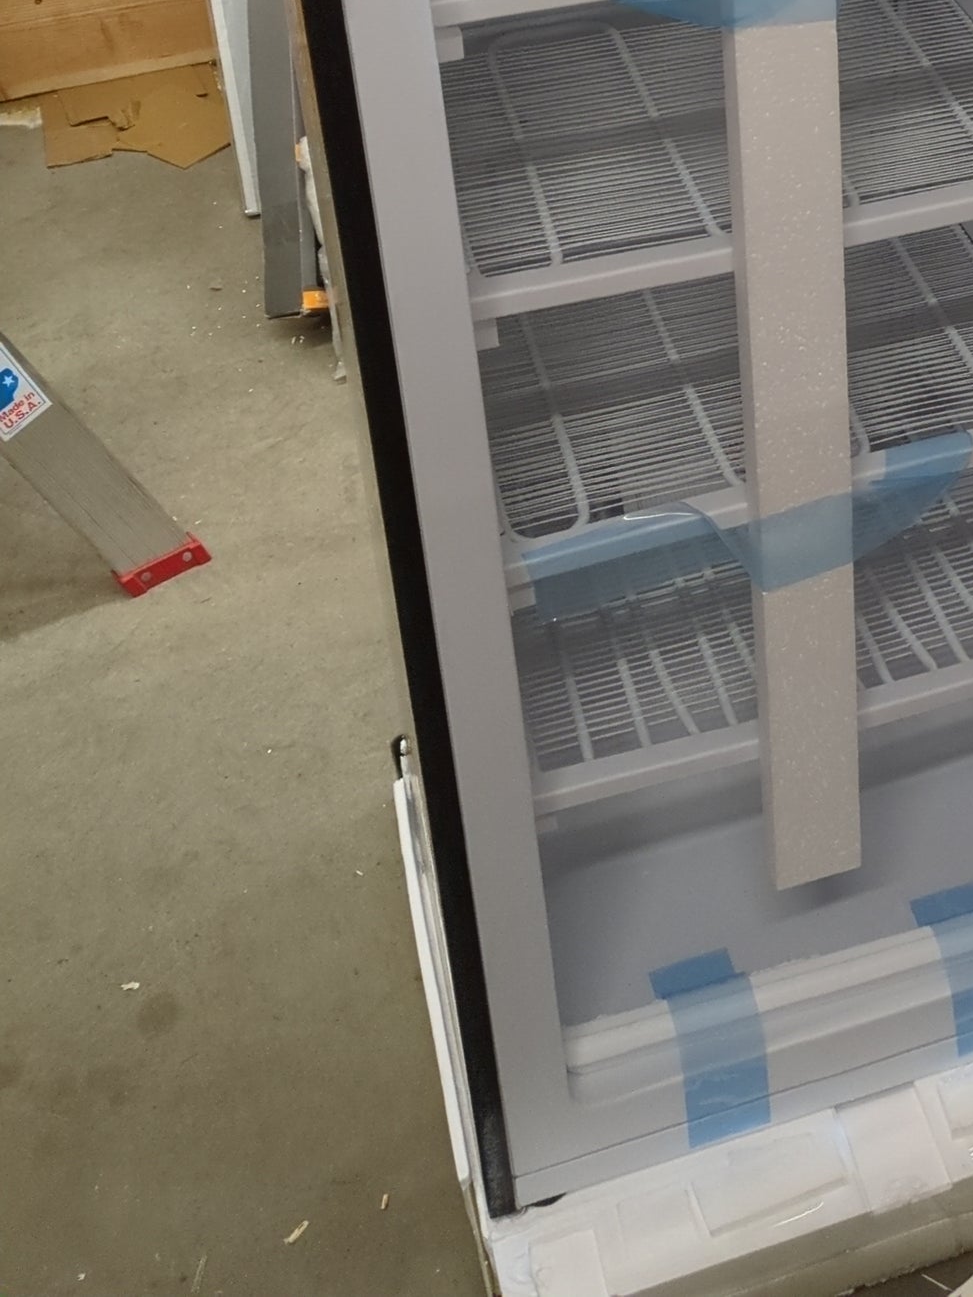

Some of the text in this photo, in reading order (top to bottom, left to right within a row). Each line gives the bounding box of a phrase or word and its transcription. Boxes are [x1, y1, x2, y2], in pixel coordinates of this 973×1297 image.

[0, 392, 35, 422] Made in
[3, 401, 41, 428] U.S.A.
